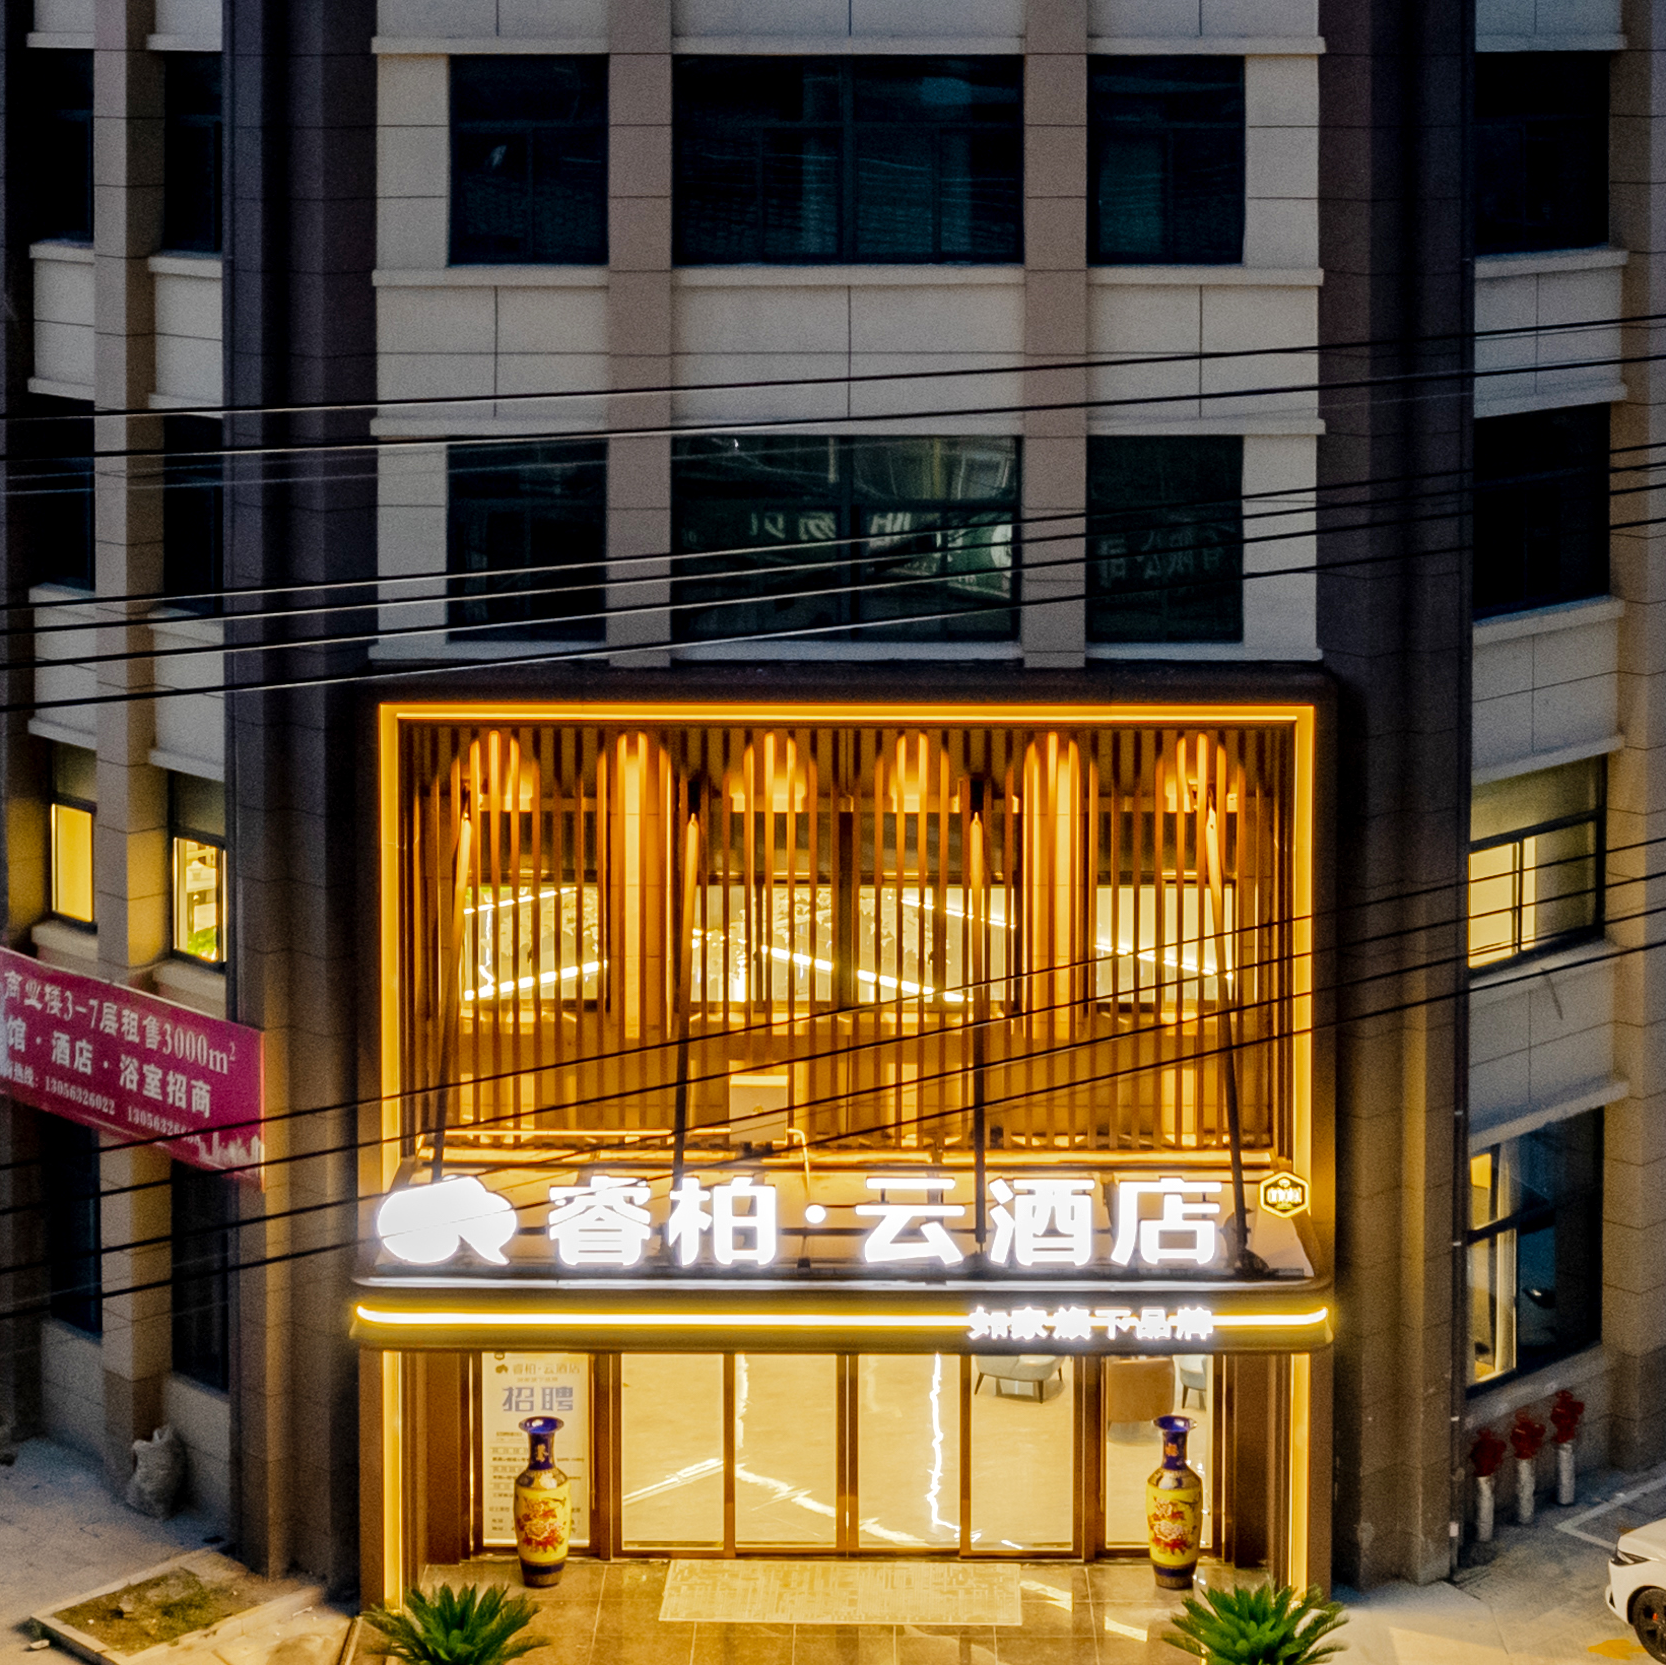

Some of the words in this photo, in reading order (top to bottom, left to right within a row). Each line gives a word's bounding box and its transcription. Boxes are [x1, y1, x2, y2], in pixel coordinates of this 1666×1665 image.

[548, 1175, 1223, 1268] 睿柏·云酒店
[968, 1305, 1214, 1340] 如家旗下品牌
[501, 1386, 574, 1412] 招聘
